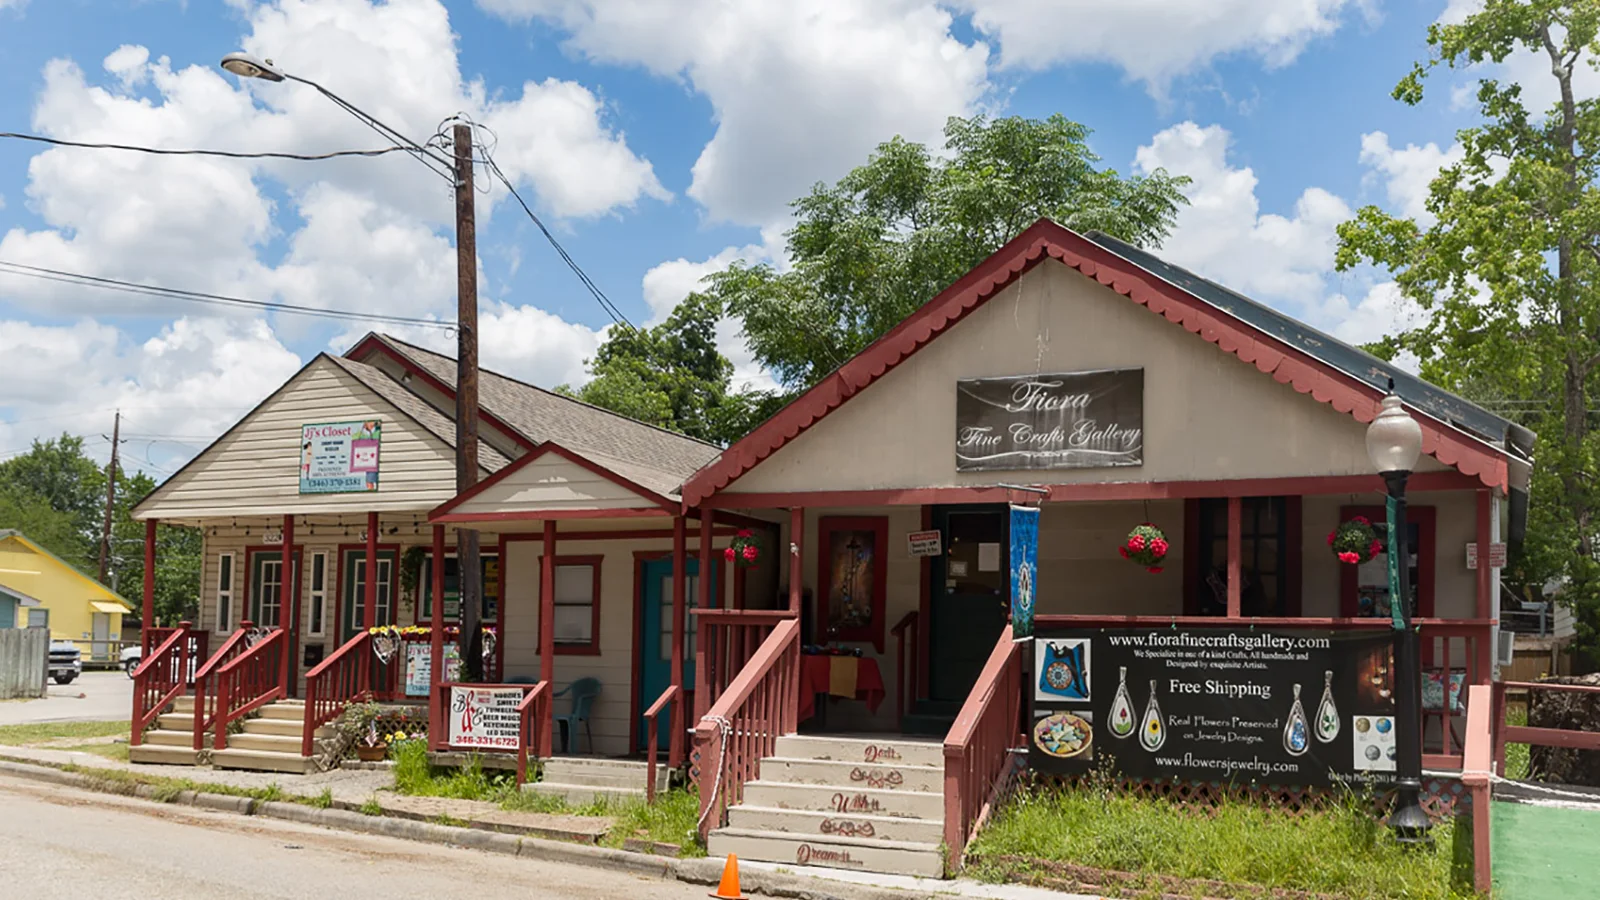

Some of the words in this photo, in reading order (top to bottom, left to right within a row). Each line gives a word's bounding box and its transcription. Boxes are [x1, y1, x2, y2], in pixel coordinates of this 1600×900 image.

[1006, 380, 1091, 413] Fiora
[321, 426, 352, 438] Closet
[957, 426, 1002, 447] Fine
[1008, 423, 1064, 449] Crafts
[1068, 419, 1141, 447] Gallery
[1109, 632, 1330, 651] www.fiorafinecraftsgallery.com
[1133, 649, 1144, 658] We
[1145, 649, 1177, 659] Specialize
[1211, 650, 1226, 659] kind
[1250, 651, 1260, 659] All
[1261, 651, 1295, 660] handmade
[1296, 652, 1309, 660] and
[1166, 659, 1198, 669] Designed
[1199, 660, 1208, 669] by
[1209, 661, 1241, 670] exquisite
[1169, 679, 1201, 693] Free
[1205, 679, 1271, 699] Shipping
[1169, 715, 1191, 726] Real
[1194, 715, 1230, 727] Flowers
[1232, 716, 1279, 729] Preserved
[1194, 730, 1226, 743] Jewelry
[1155, 753, 1299, 777] www.flowersjewelry.com
